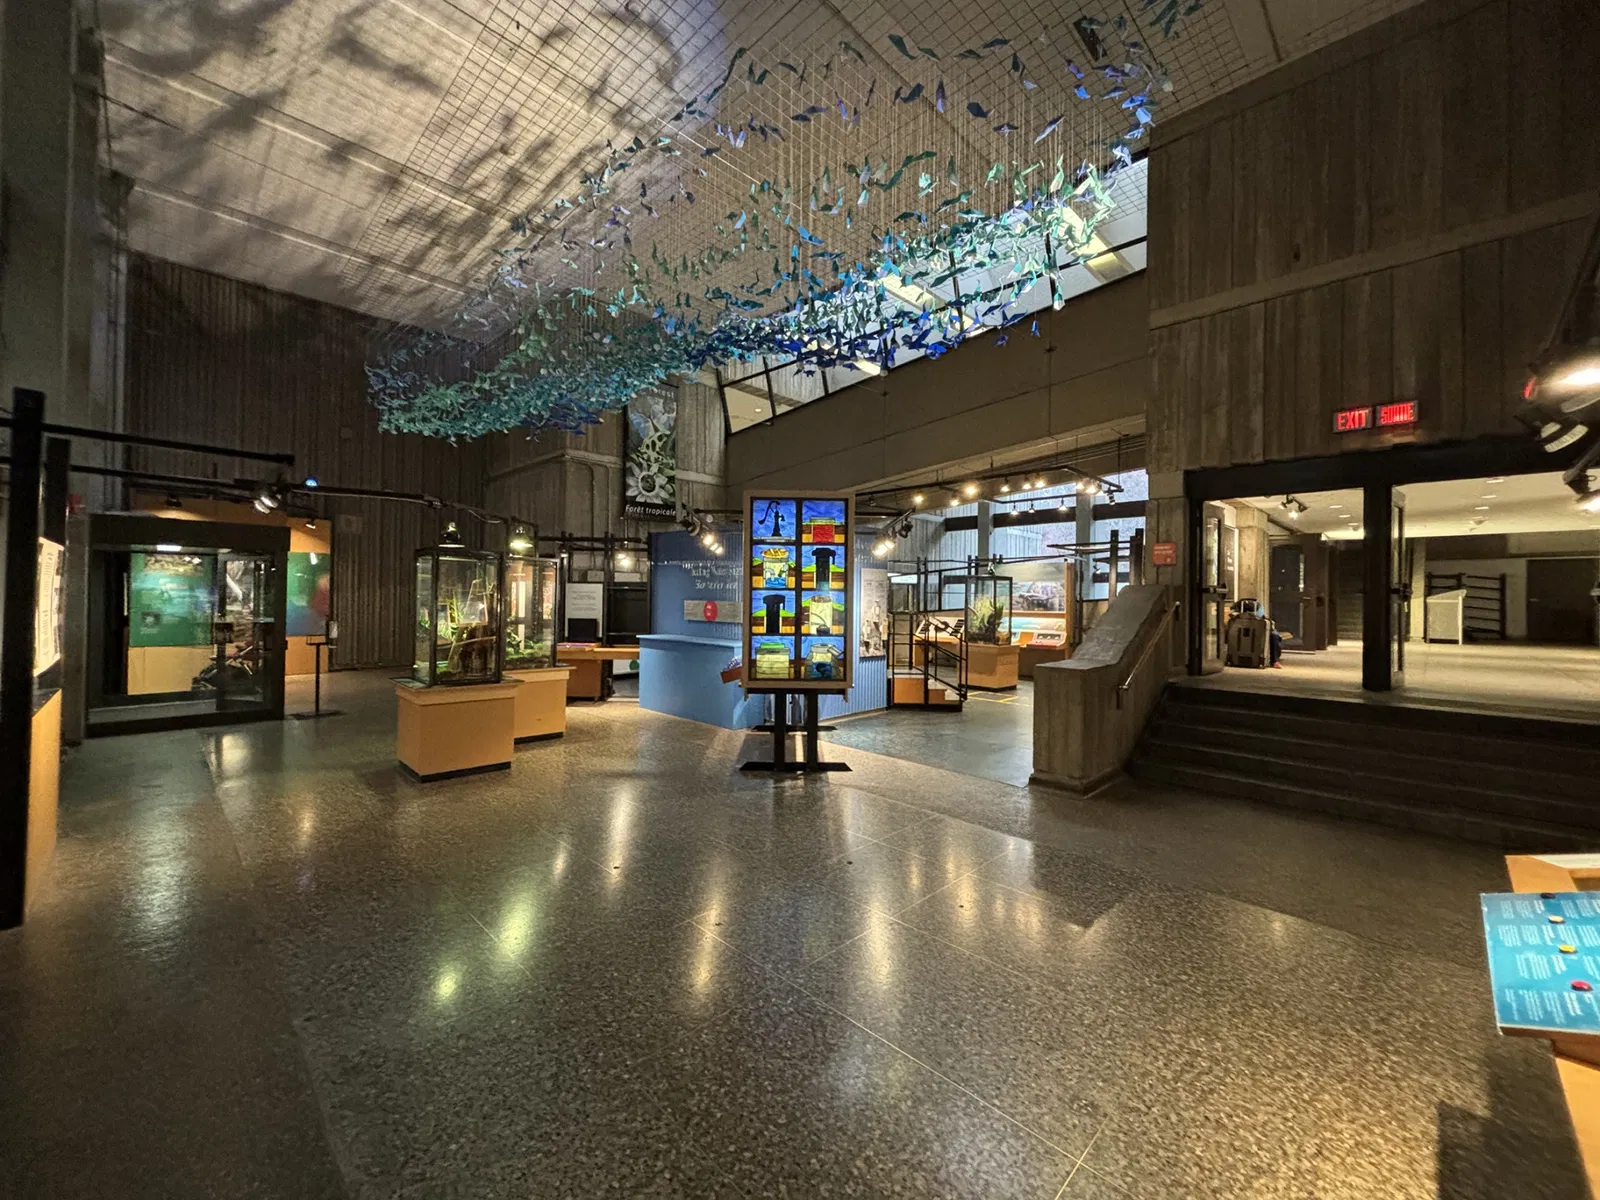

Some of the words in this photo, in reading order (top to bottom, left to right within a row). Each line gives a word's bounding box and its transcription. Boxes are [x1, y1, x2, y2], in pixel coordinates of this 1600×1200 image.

[1337, 409, 1369, 430] EXIT
[1381, 402, 1414, 424] SORTIE
[645, 507, 676, 516] tropicale
